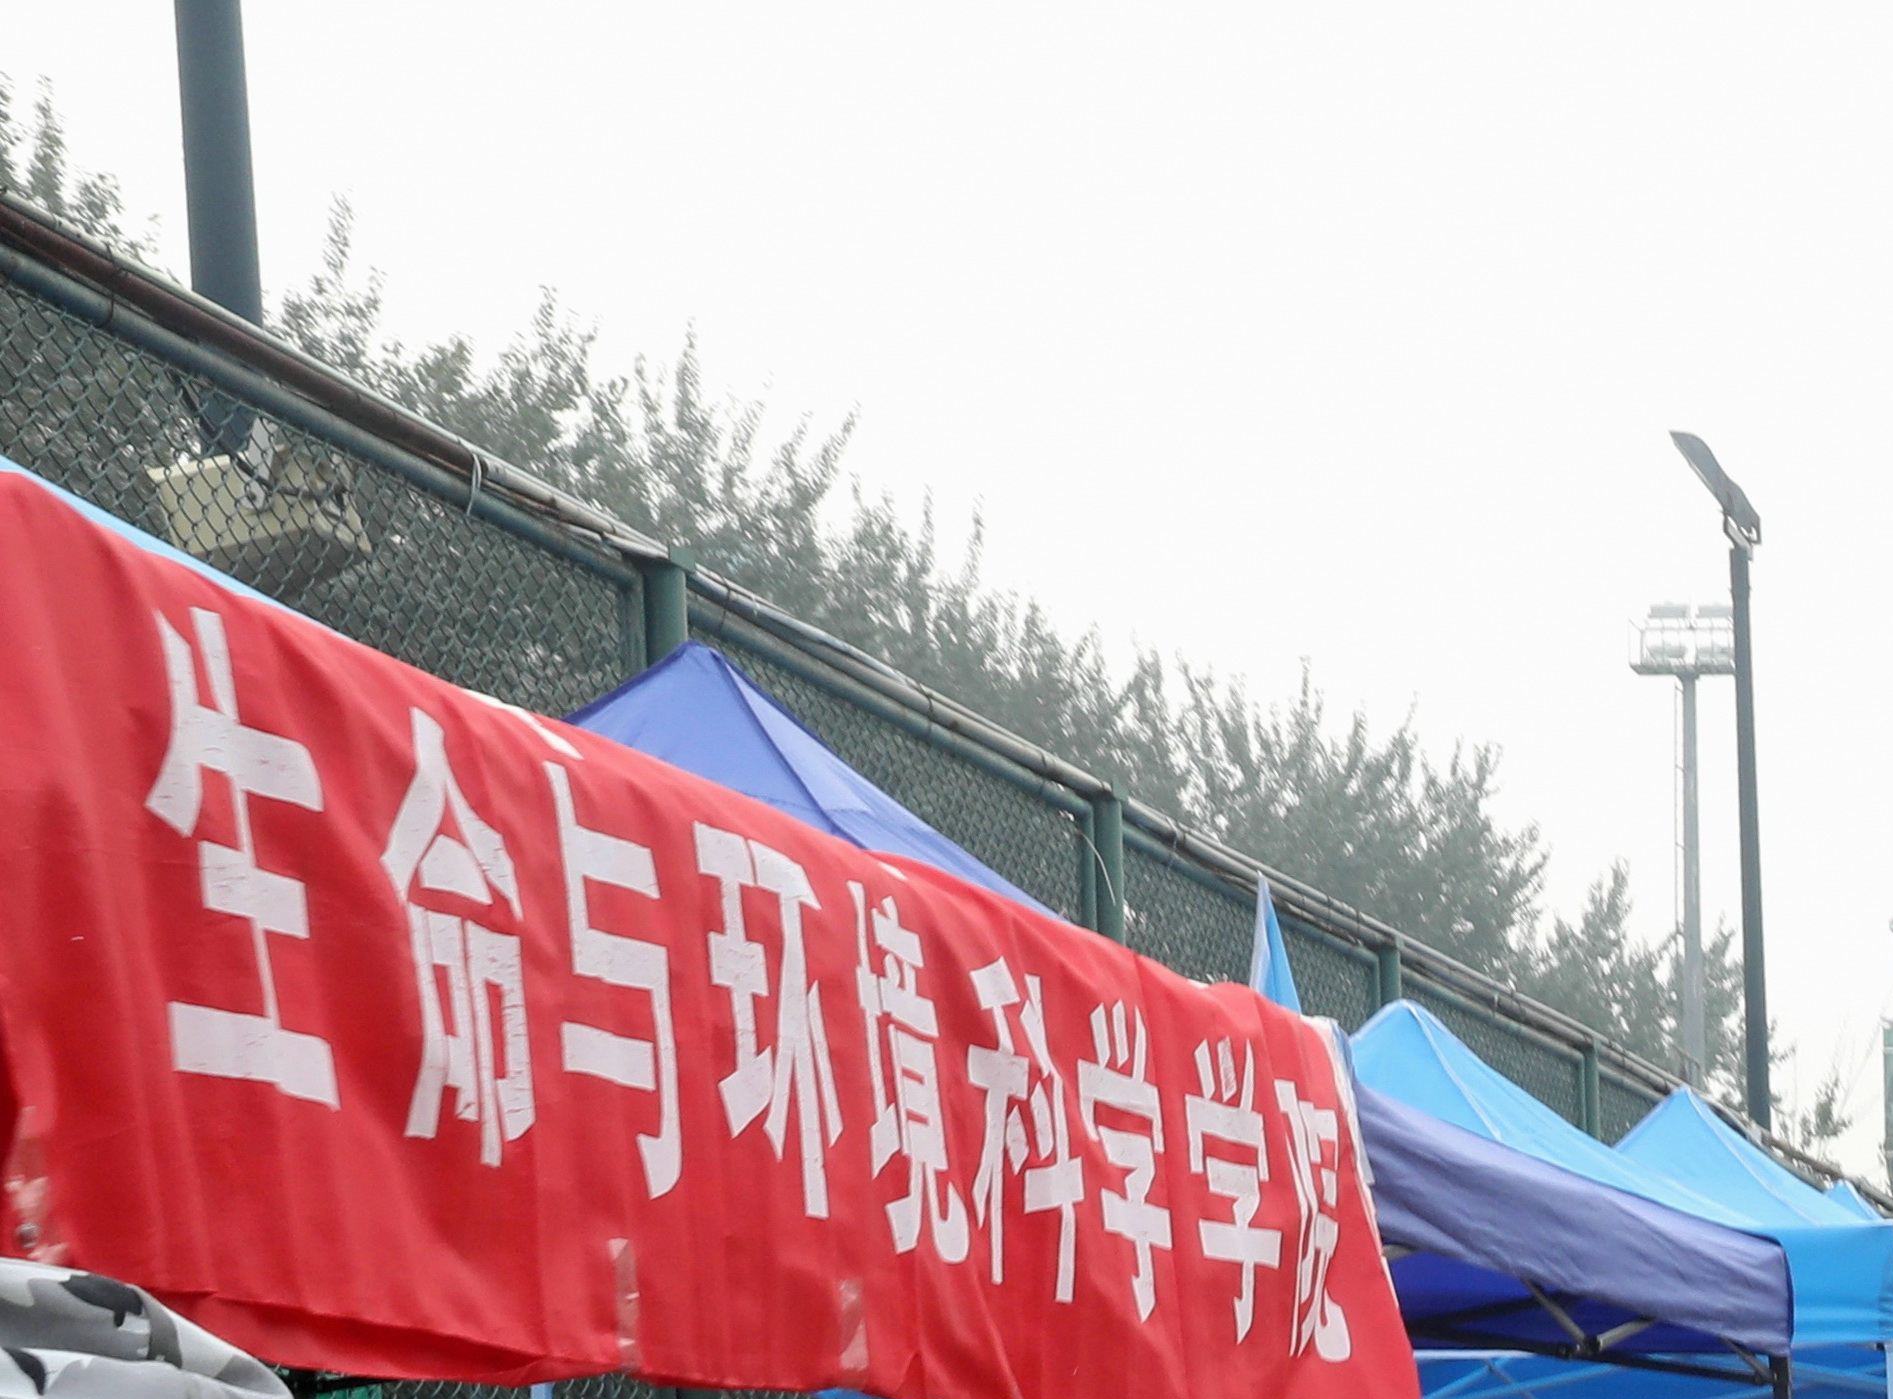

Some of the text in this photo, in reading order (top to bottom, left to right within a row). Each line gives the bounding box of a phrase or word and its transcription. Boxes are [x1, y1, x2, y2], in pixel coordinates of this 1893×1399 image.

[146, 607, 1352, 1363] 生命与环境科学学院
